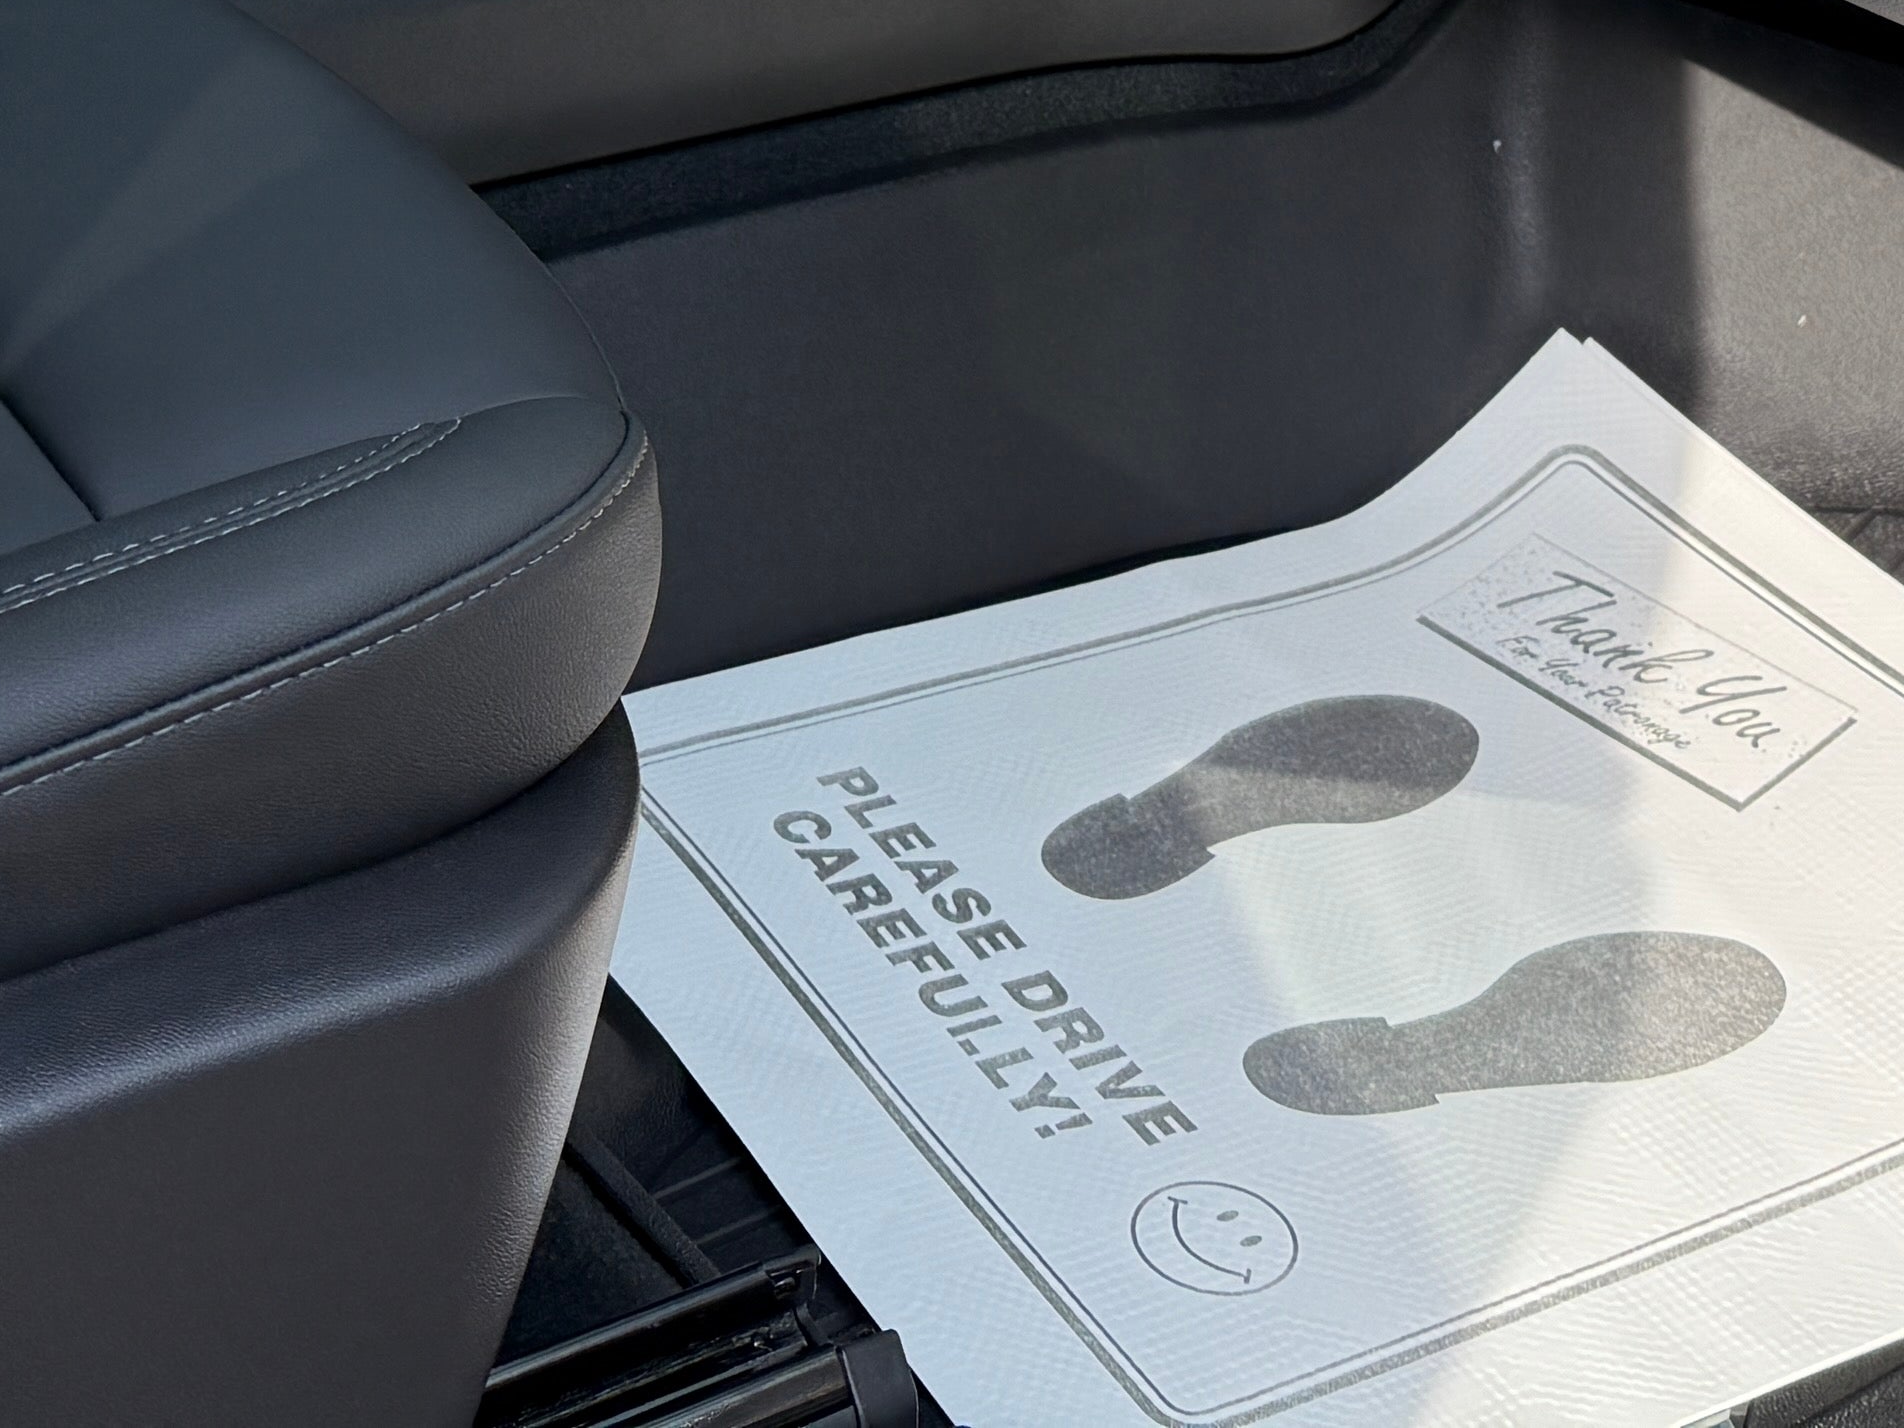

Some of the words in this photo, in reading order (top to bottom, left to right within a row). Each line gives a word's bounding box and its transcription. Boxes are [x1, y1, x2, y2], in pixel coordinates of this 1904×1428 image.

[1496, 569, 1715, 686] Thank
[1679, 674, 1788, 750] You
[1496, 633, 1540, 663] For
[1540, 655, 1586, 690] Your
[1585, 684, 1692, 750] Patronage
[773, 810, 1094, 1140] CAREFULLY!
[816, 766, 1028, 961] PLEASE
[1001, 970, 1199, 1146] DRIVE
